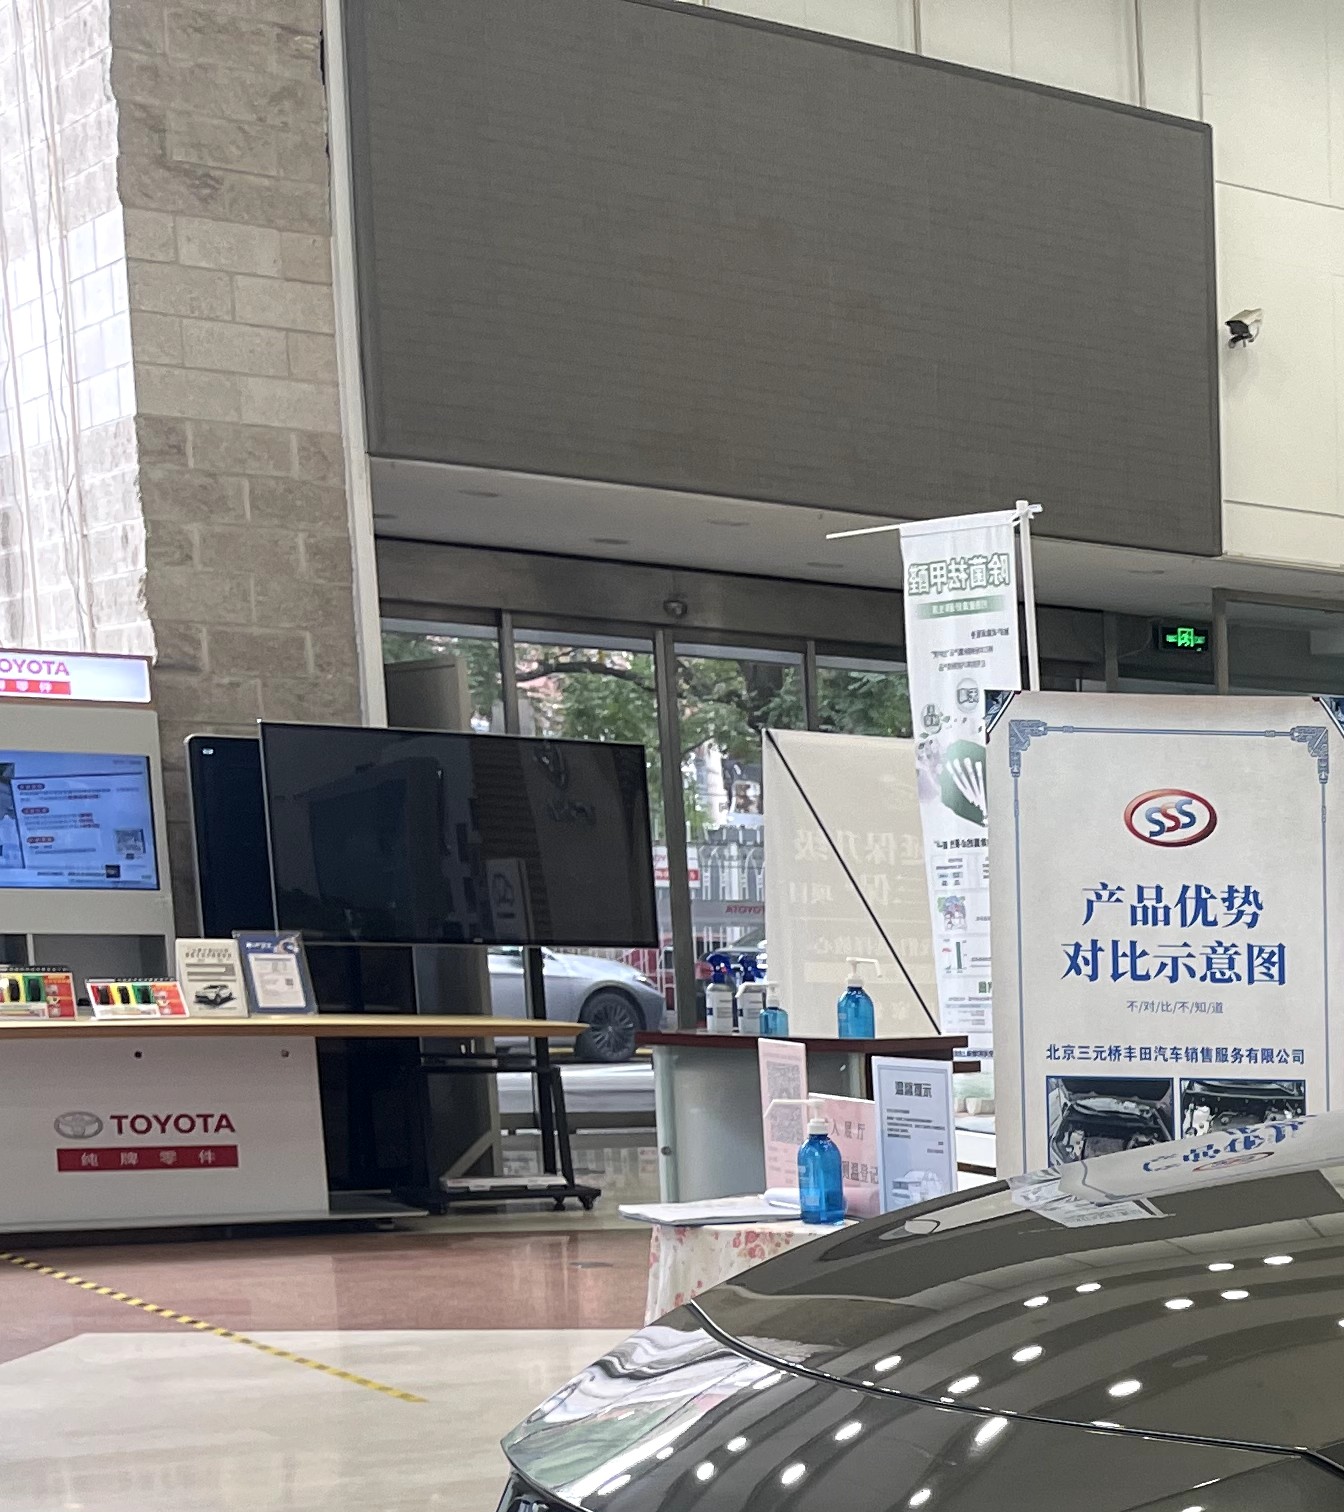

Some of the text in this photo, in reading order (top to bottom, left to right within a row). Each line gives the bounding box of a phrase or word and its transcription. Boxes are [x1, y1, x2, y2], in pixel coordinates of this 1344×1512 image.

[0, 658, 70, 676] OYOTA
[1082, 882, 1264, 929] 产品优势
[1060, 939, 1286, 986] 对比示意图
[1127, 1000, 1224, 1014] 不/对/比/不/知/道
[1045, 1044, 1305, 1065] 北京三元桥丰田汽车销售服务有限公司
[110, 1113, 236, 1134] TOYOTA
